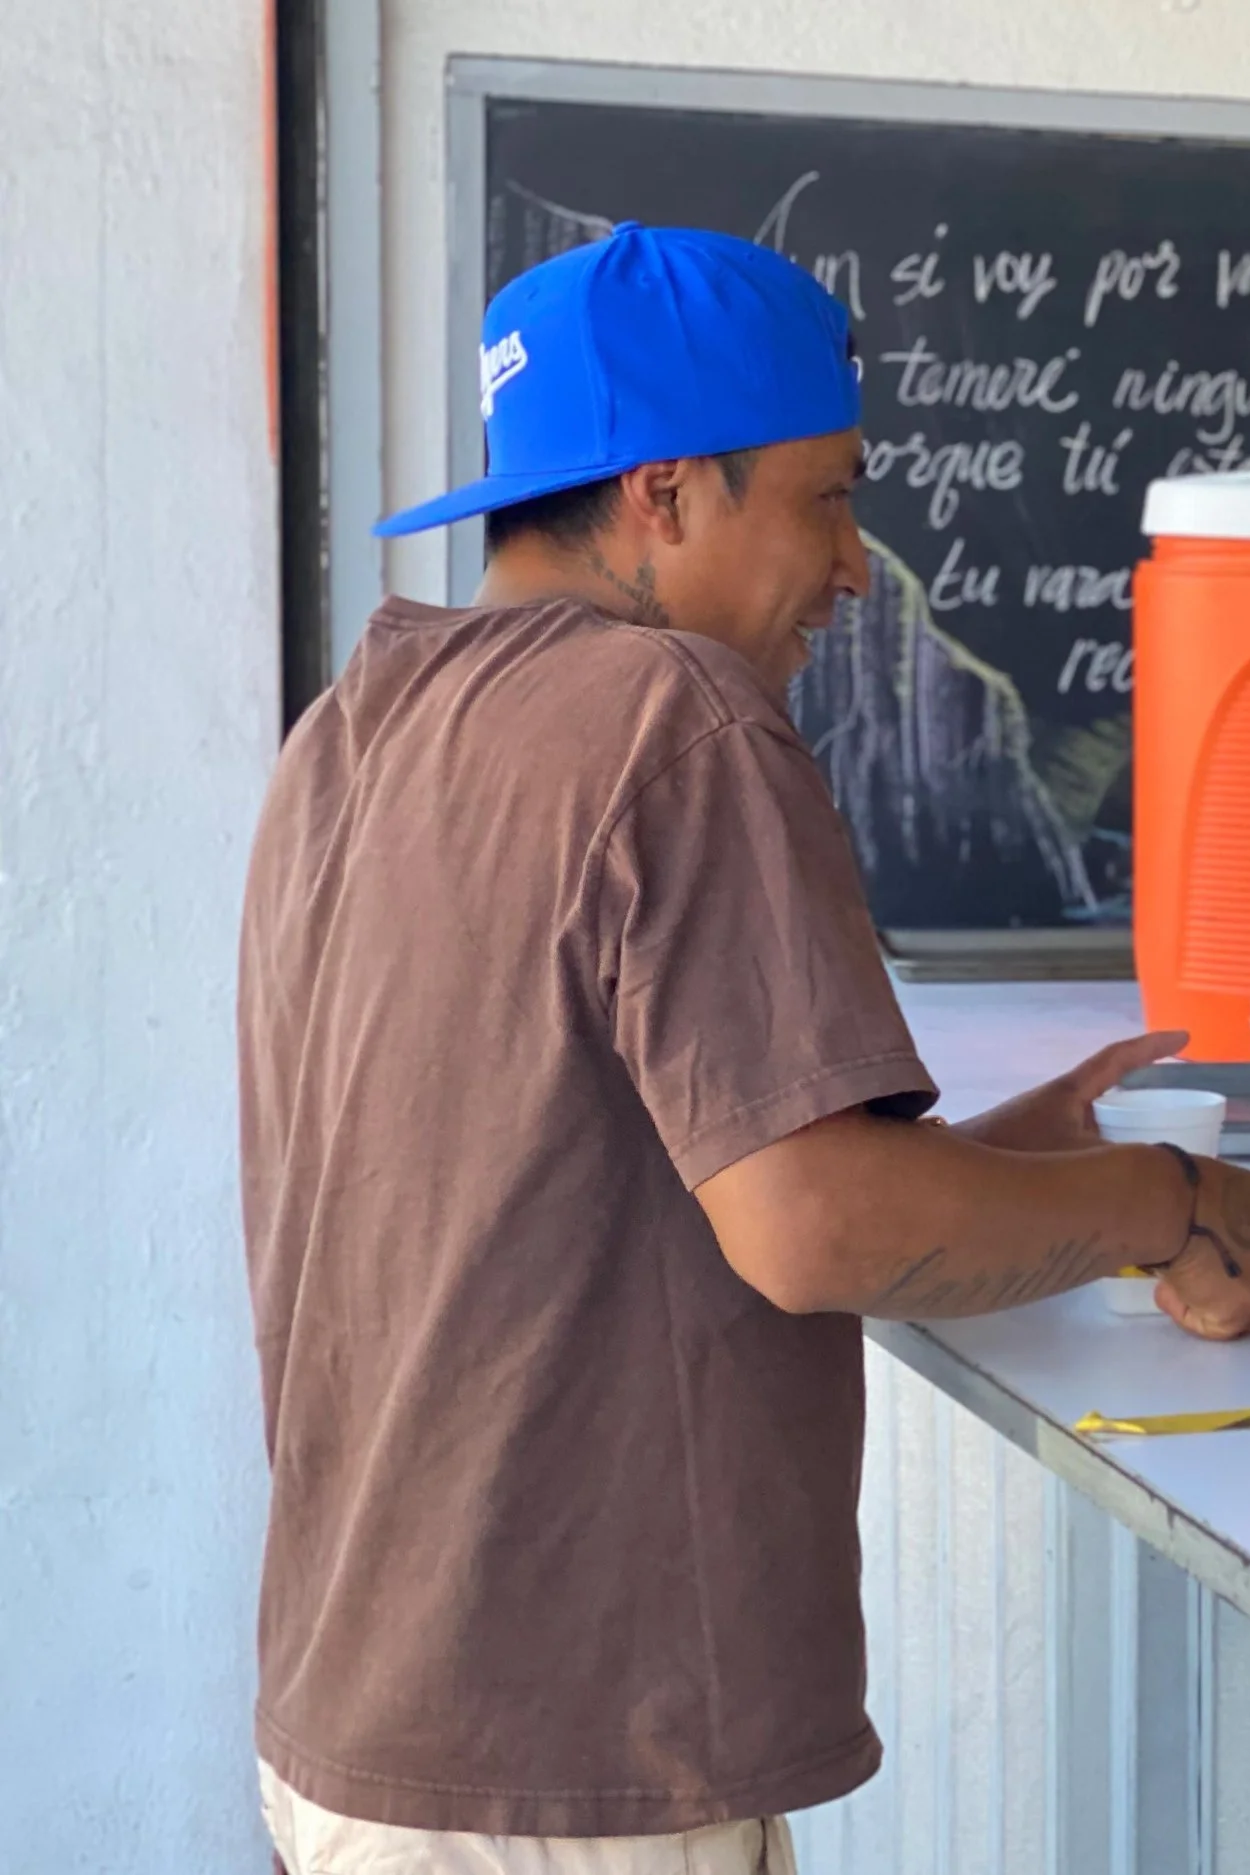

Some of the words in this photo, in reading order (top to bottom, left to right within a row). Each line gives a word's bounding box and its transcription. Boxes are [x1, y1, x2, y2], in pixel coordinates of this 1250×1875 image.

[890, 222, 945, 306] si
[973, 250, 1057, 320] voy
[1084, 239, 1181, 328] por
[863, 431, 1024, 530] orque
[1060, 420, 1134, 495] tú
[929, 536, 1001, 611] tu
